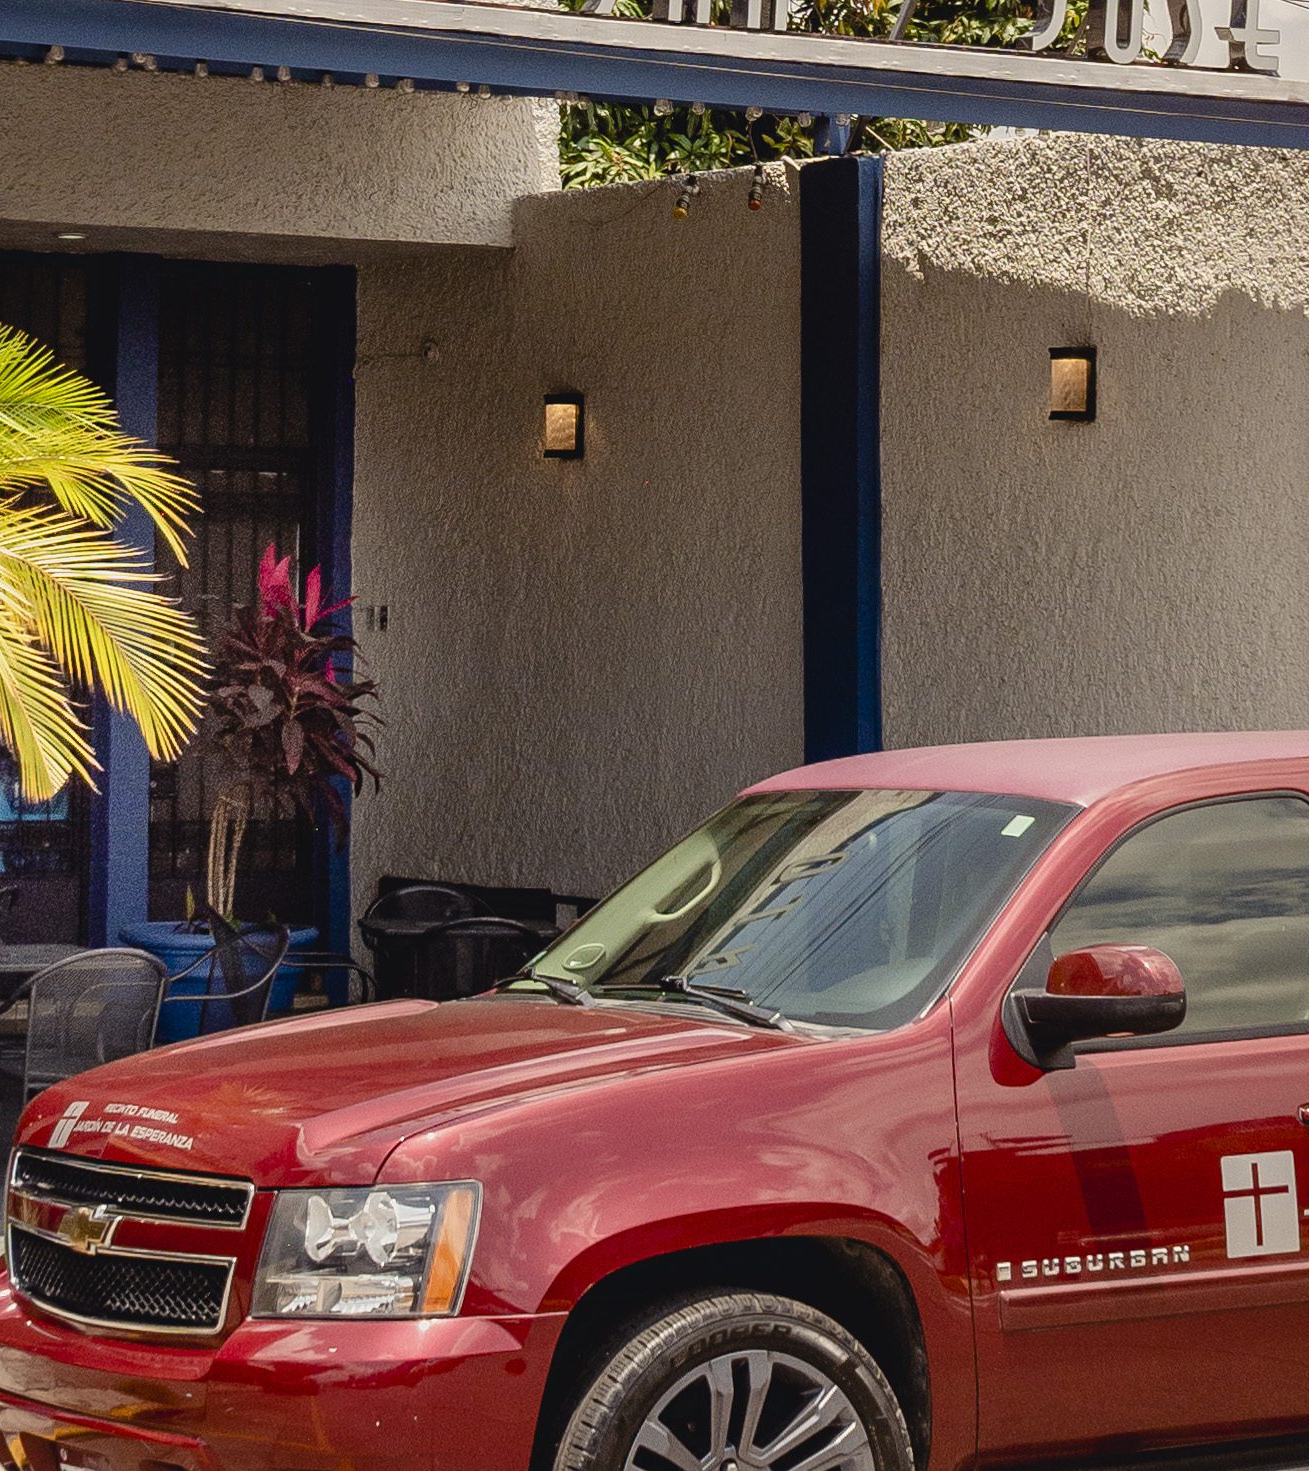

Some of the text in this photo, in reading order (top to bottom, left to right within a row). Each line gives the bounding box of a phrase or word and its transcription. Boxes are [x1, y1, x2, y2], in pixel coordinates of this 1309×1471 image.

[137, 1107, 180, 1125] FUNERAL
[101, 1120, 117, 1134] DE
[114, 1121, 131, 1136] LA
[130, 1125, 195, 1151] ESPERANZA
[1021, 1244, 1191, 1279] SUBURBAN
